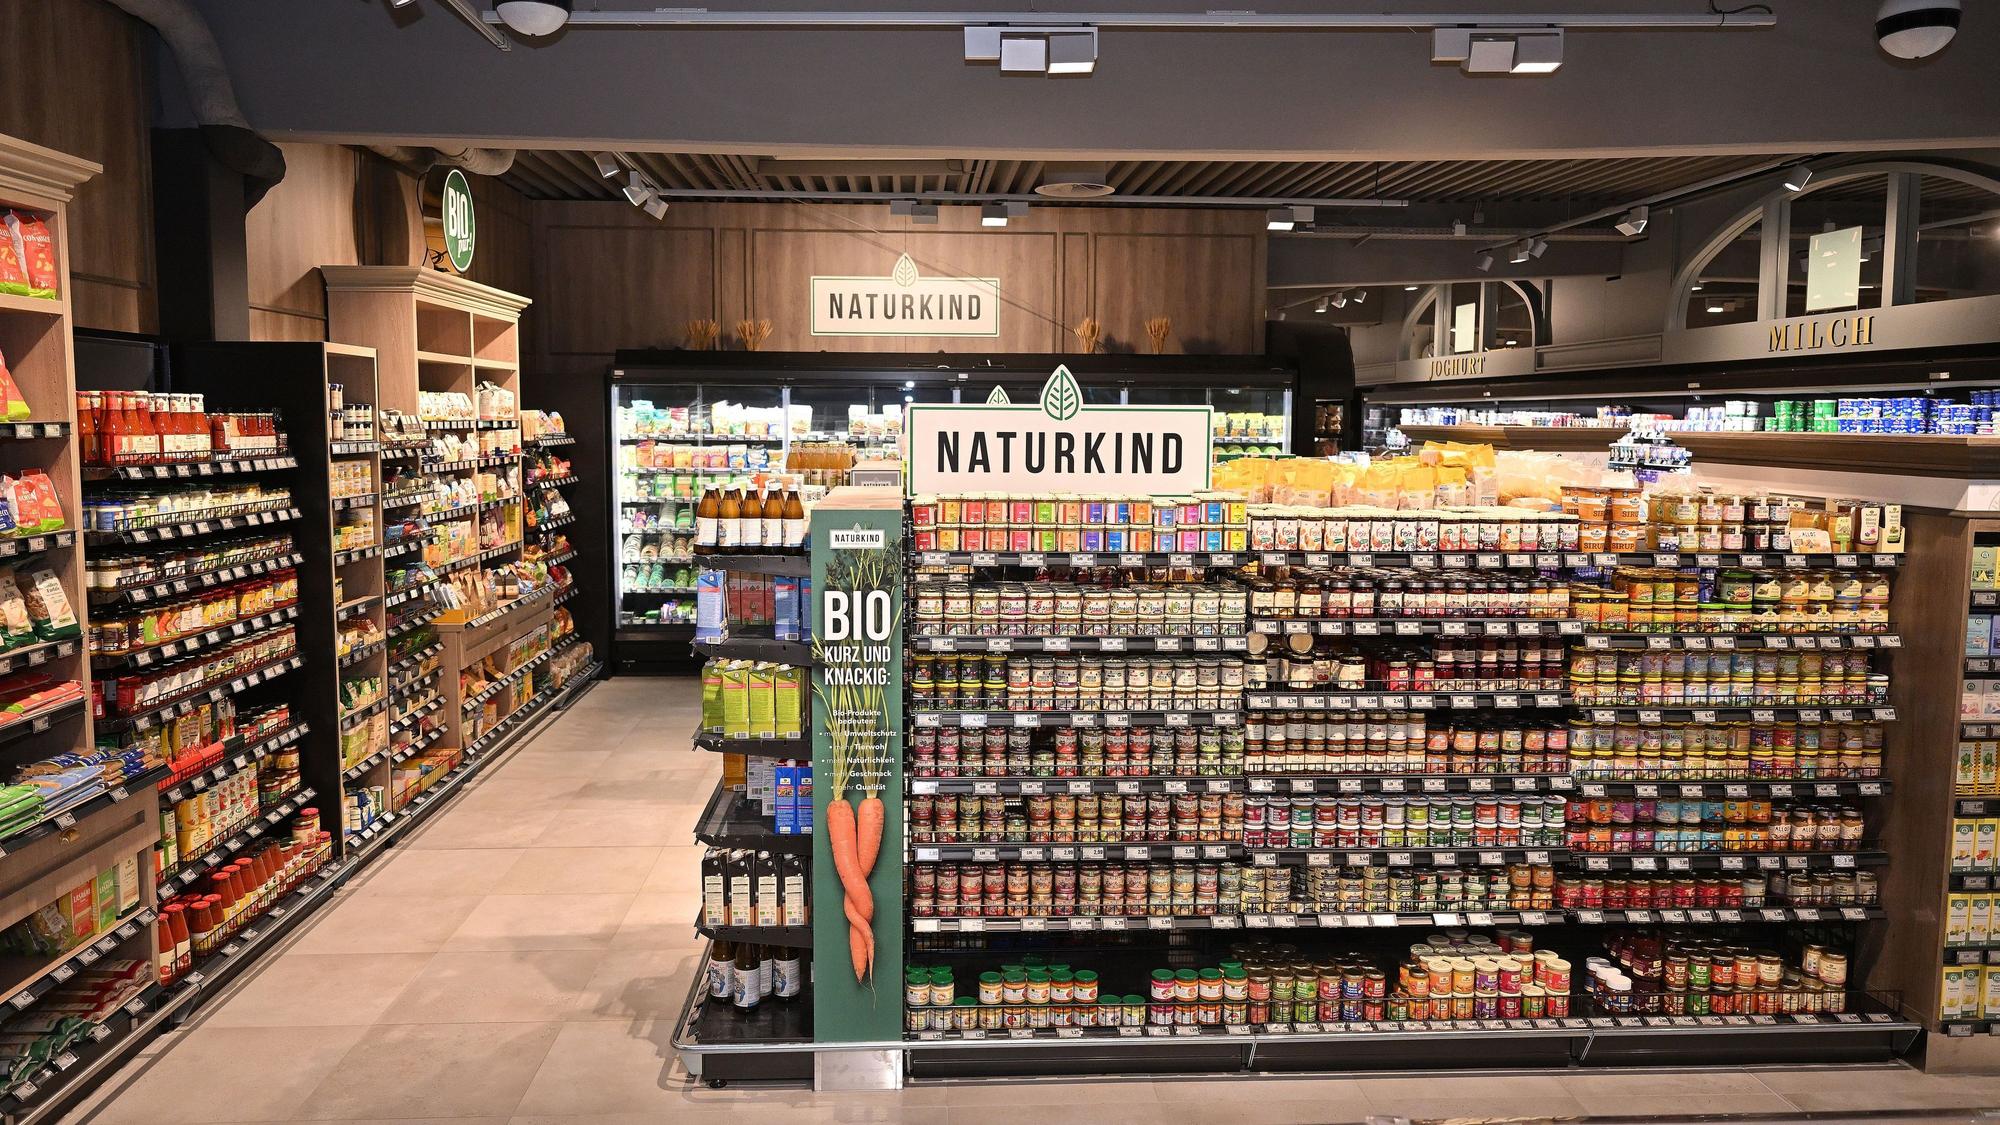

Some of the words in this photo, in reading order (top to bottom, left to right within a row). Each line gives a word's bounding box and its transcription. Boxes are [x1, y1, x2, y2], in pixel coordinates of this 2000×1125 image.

[448, 187, 469, 239] BIO
[829, 293, 981, 320] NATURKIND
[1768, 316, 1875, 352] MILCH
[1428, 357, 1486, 381] JOGHURT
[937, 431, 1182, 474] NATURKIND
[834, 534, 880, 543] NATURKIND
[824, 590, 891, 641] BIO
[824, 646, 860, 662] KURZ
[863, 646, 891, 662] UND
[824, 668, 891, 685] KNACKIG:
[832, 709, 882, 717] Bio-Produkte
[844, 729, 897, 737] Umweltschutz
[855, 783, 886, 791] Qualität
